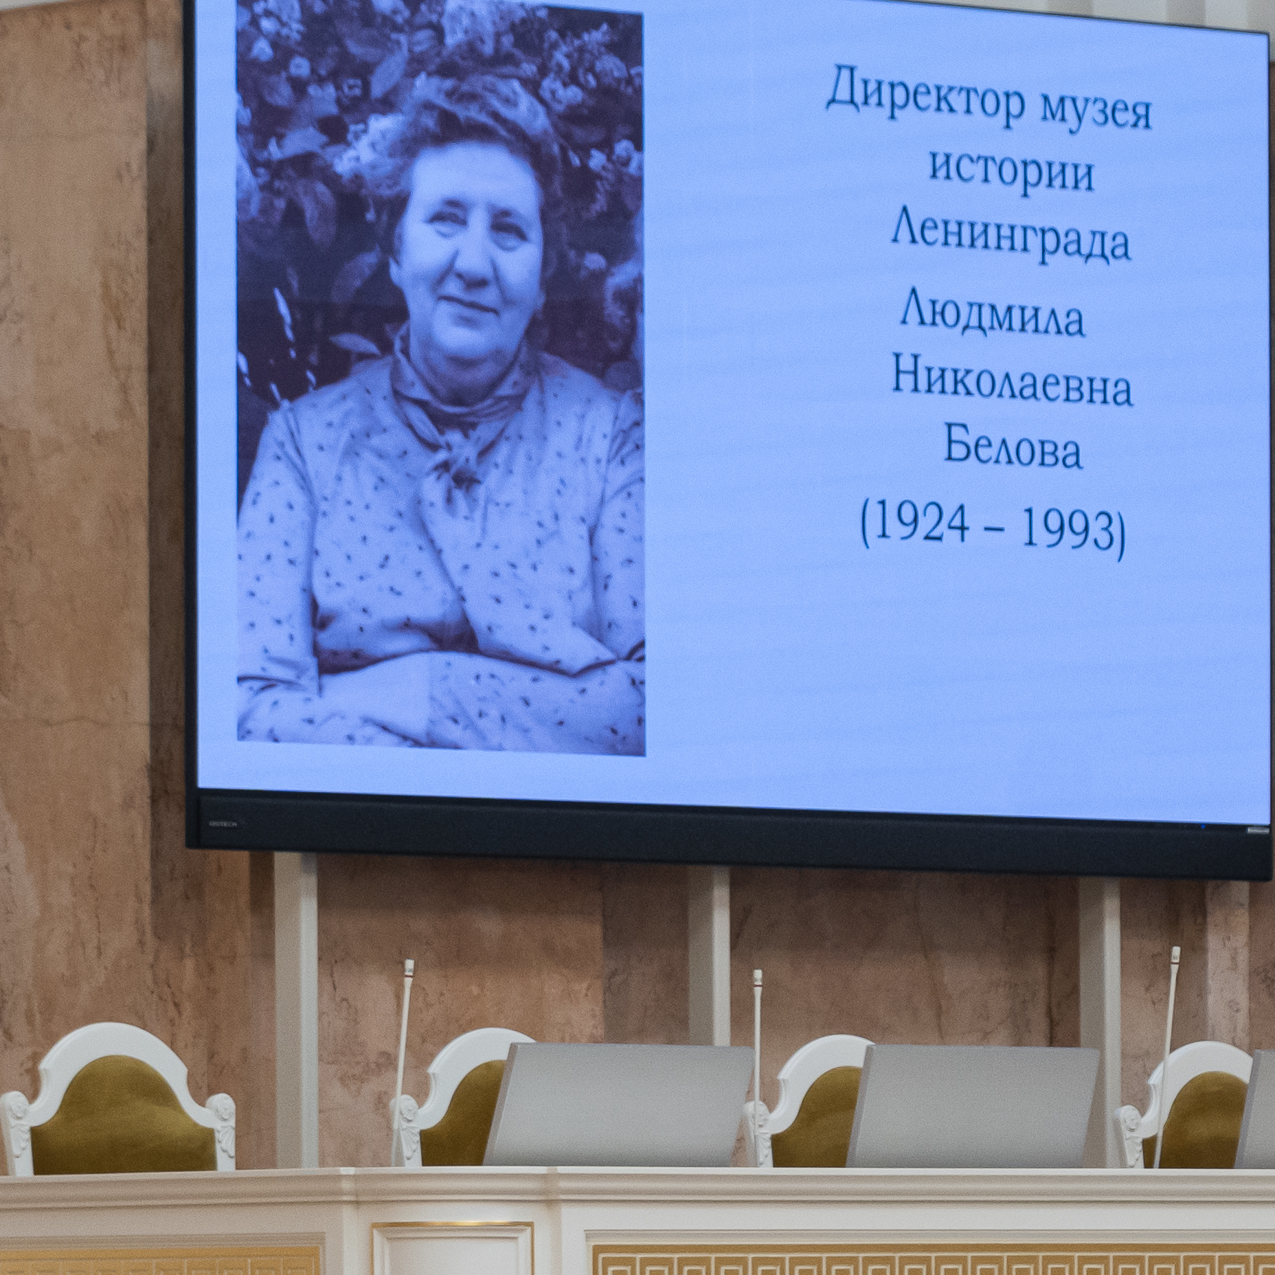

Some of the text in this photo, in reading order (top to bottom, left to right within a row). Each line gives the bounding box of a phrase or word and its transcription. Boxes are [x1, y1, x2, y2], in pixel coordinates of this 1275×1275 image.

[825, 62, 1153, 136] Директор музея
[928, 149, 1096, 199] истории
[890, 203, 1133, 267] Ленинграда
[899, 284, 1087, 338] Людмила
[891, 350, 1135, 408] Николаевна
[943, 420, 1085, 470] Белова
[859, 496, 971, 551] (1924
[1022, 505, 1127, 564] 1993)
